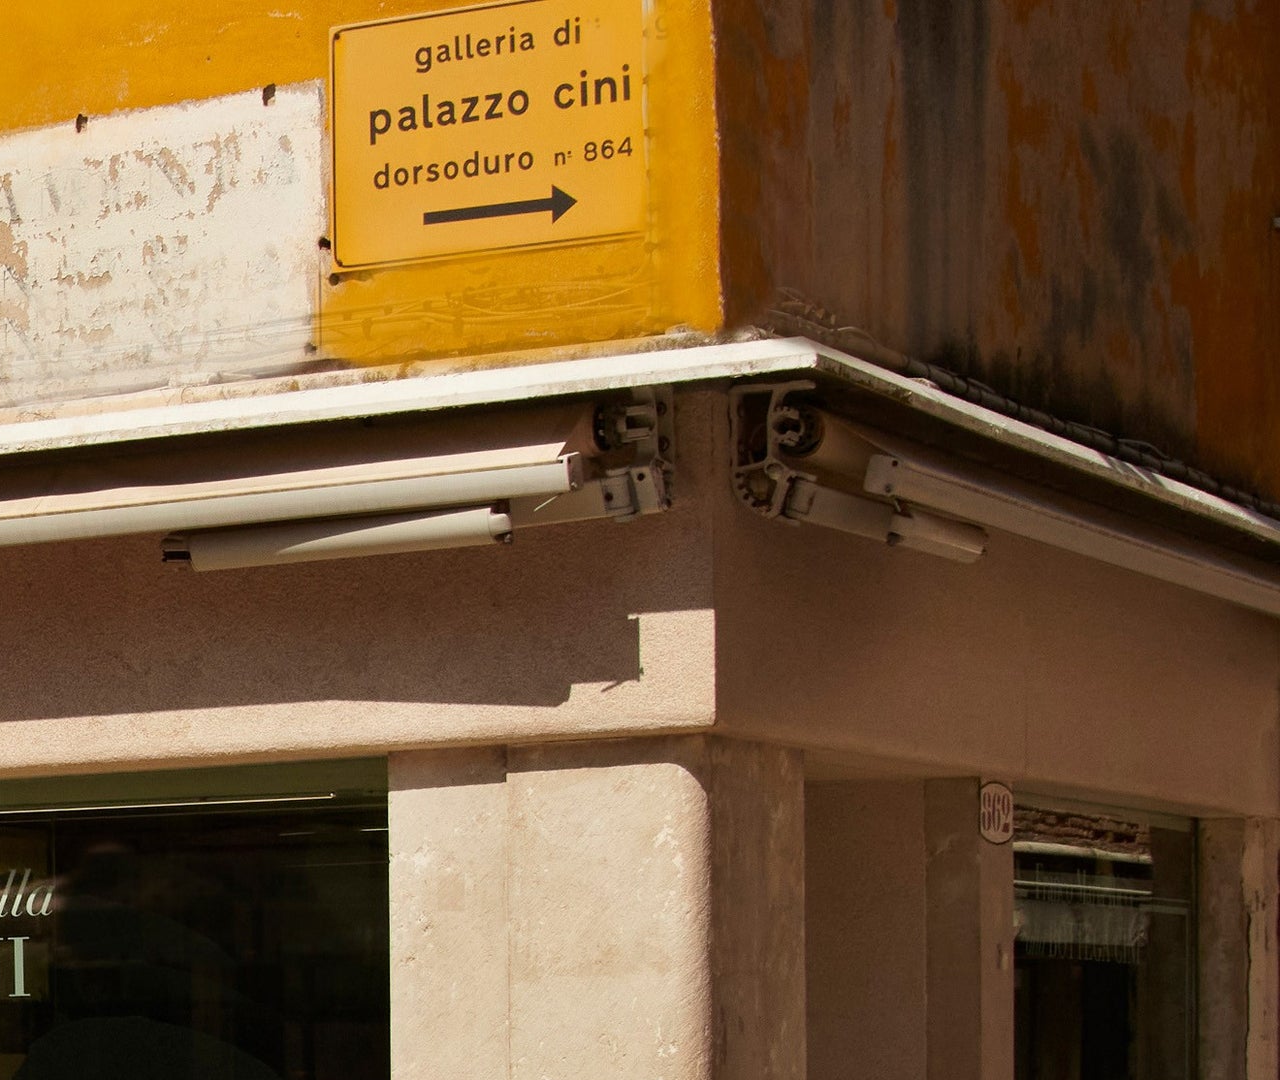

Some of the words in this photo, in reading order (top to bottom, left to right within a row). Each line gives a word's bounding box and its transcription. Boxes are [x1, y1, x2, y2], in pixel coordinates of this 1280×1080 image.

[414, 26, 536, 74] galleria
[553, 16, 582, 47] di
[369, 88, 530, 146] palazzo
[553, 63, 631, 110] cini
[373, 150, 535, 190] dorsoduro
[583, 136, 633, 162] 864
[982, 791, 1011, 833] 862
